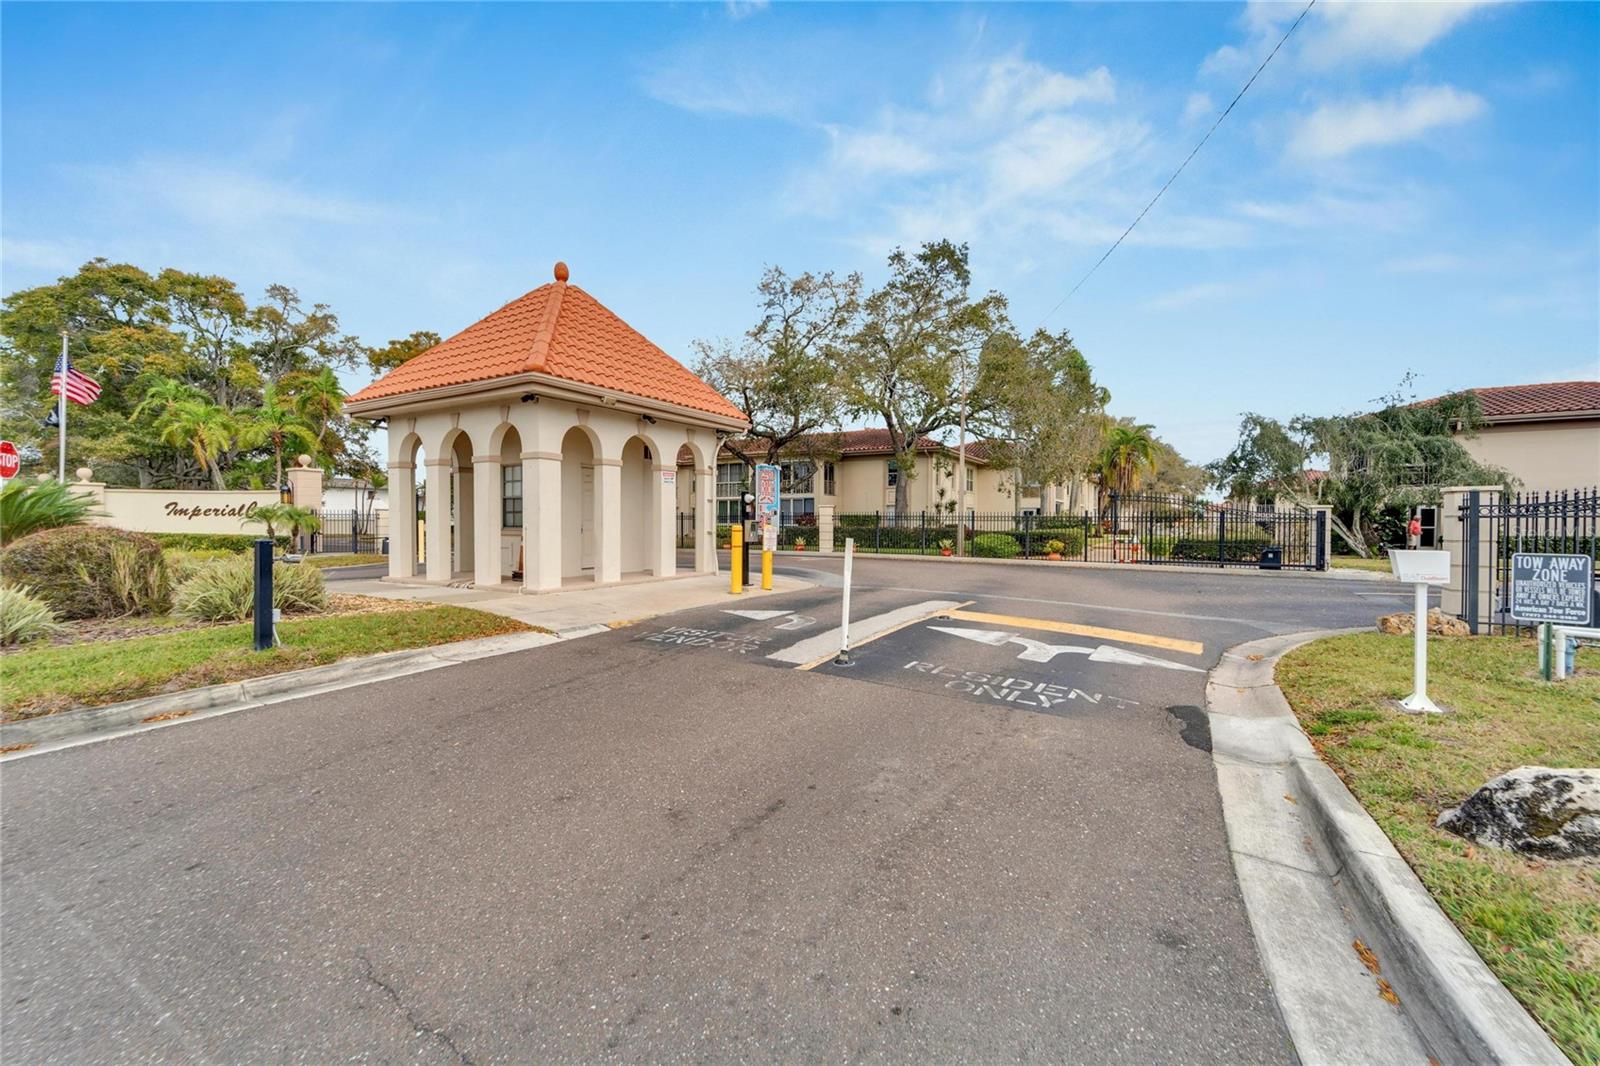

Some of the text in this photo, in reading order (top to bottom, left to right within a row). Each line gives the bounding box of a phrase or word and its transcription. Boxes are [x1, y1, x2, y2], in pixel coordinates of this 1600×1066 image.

[164, 501, 244, 520] Imperial
[1516, 556, 1586, 570] TOW AWAY
[1532, 569, 1568, 582] ZONE
[1515, 605, 1586, 616] American Tow Force
[903, 660, 1141, 710] RESIDENT
[944, 679, 1067, 709] ONLY
